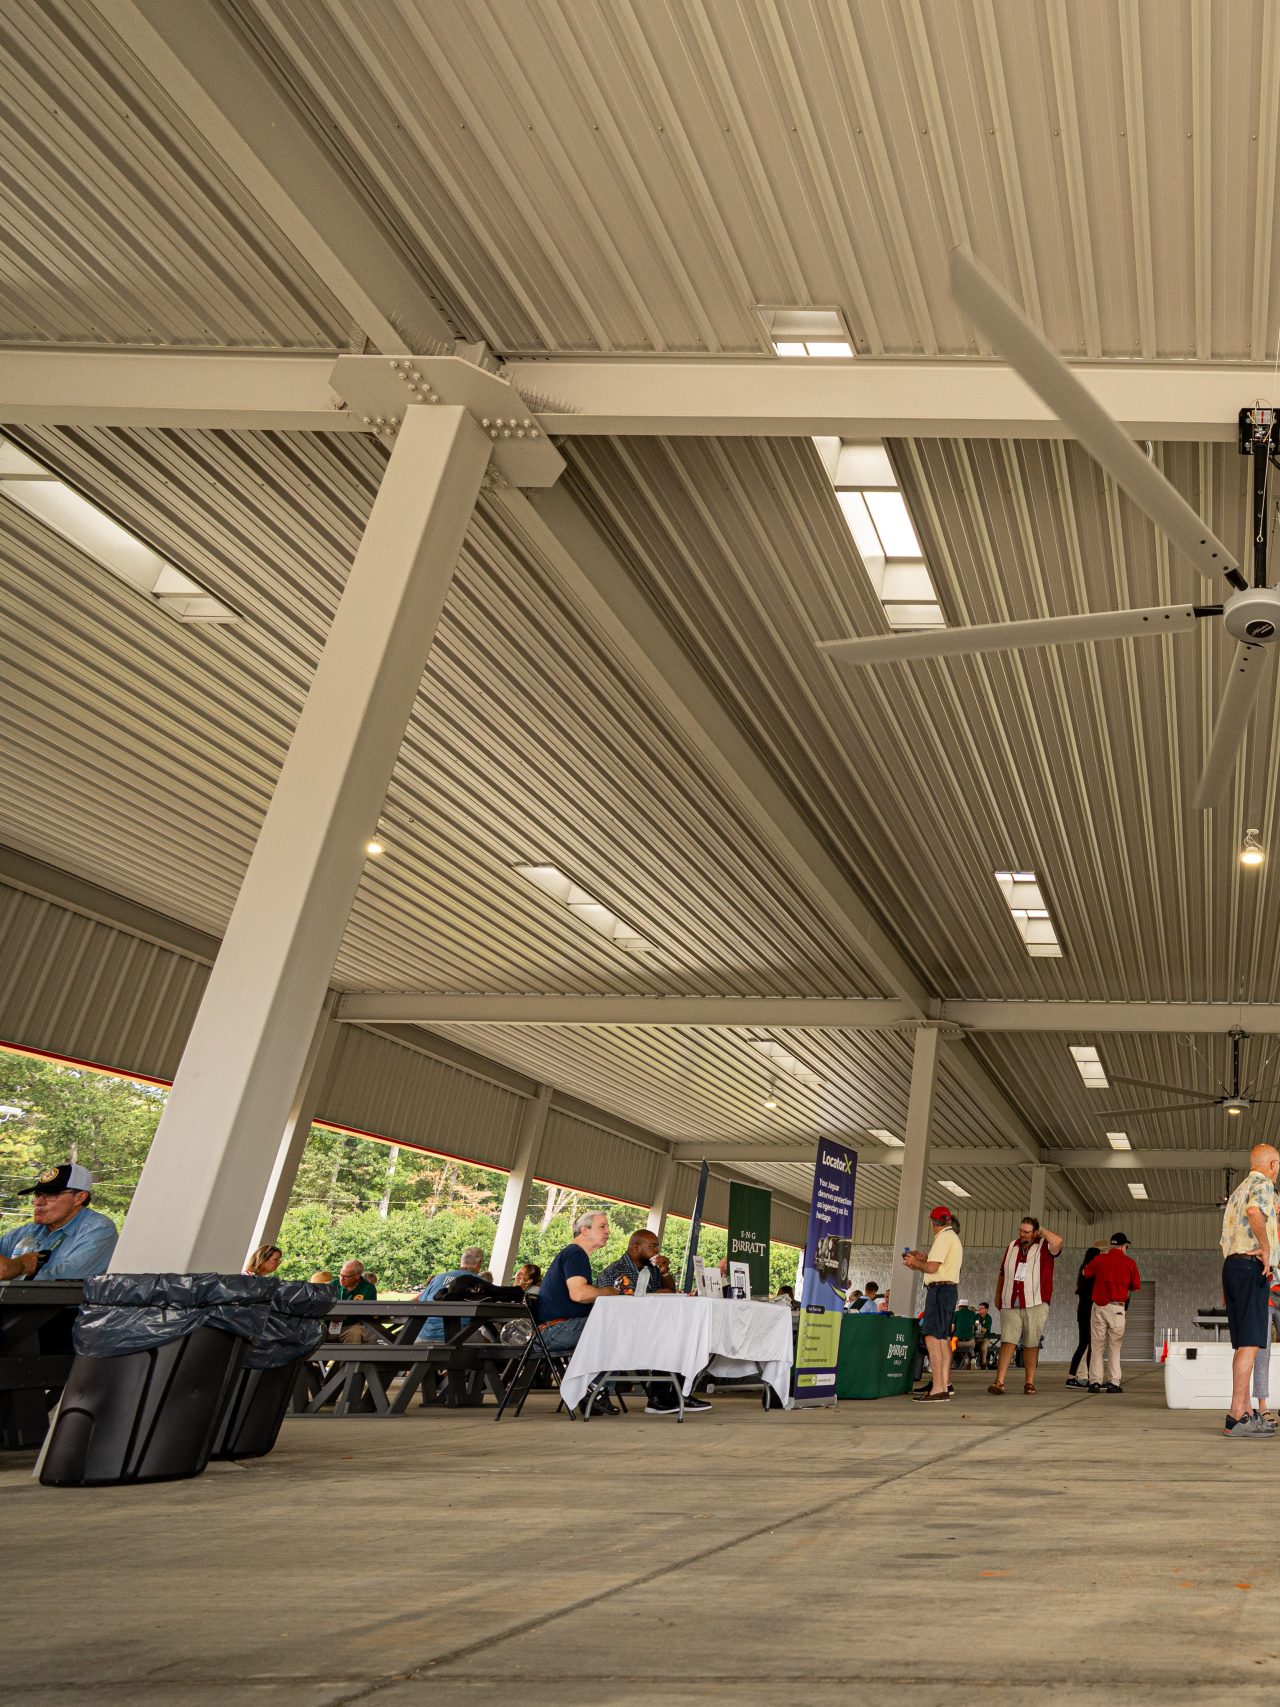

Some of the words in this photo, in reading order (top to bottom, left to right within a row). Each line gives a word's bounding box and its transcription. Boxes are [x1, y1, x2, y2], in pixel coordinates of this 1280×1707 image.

[822, 1150, 852, 1174] LocatorX
[819, 1177, 828, 1187] Your
[828, 1180, 840, 1192] Jaguar
[818, 1190, 833, 1200] deserves
[833, 1195, 852, 1206] protection
[823, 1202, 839, 1214] legendary
[731, 1238, 767, 1257] BARRATT
[886, 1343, 909, 1360] BARRATT
